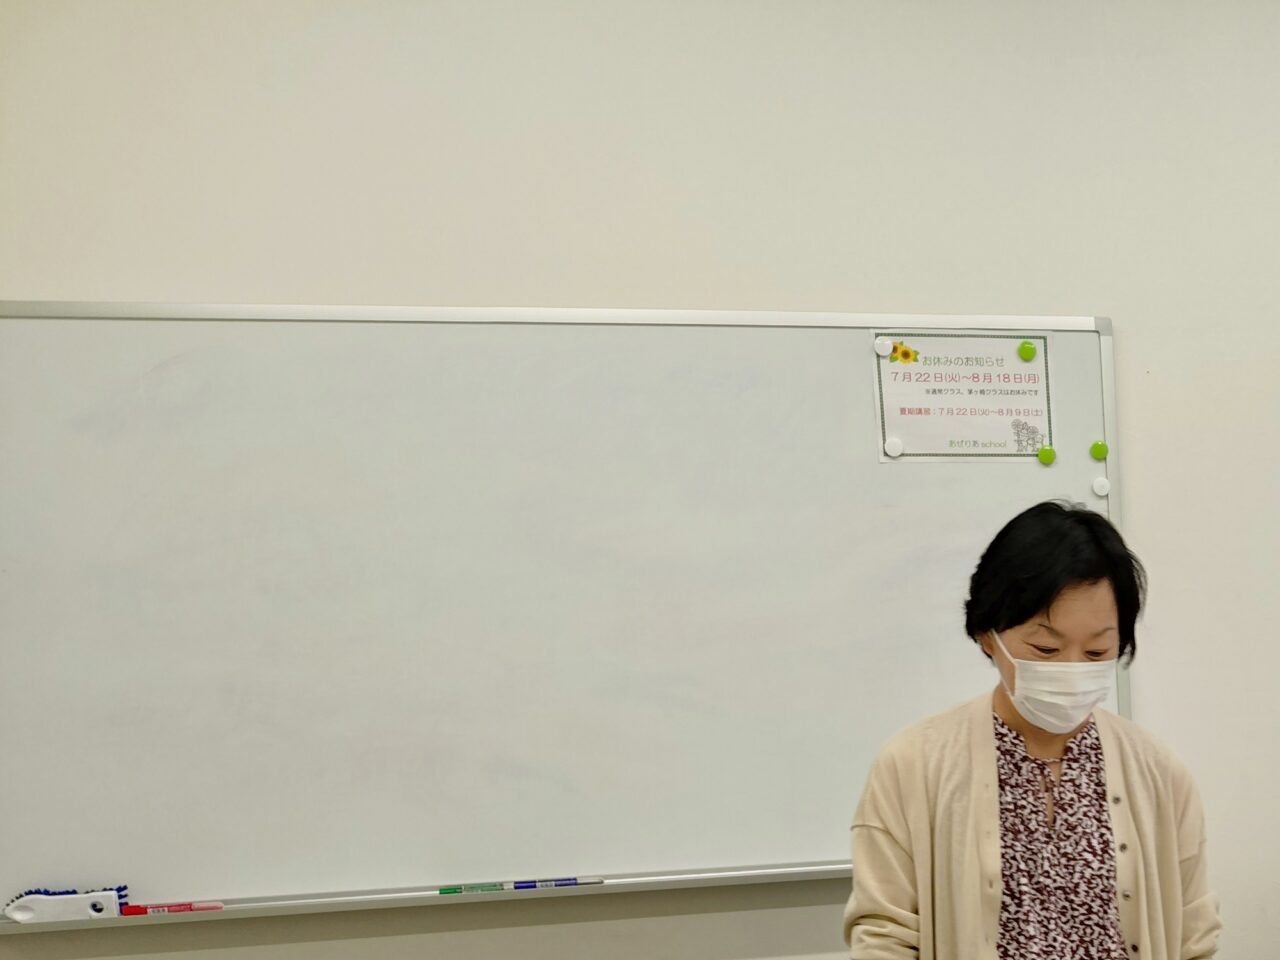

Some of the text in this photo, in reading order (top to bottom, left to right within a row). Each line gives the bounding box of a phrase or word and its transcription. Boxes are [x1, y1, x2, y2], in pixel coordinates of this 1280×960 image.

[922, 355, 1005, 368] お休みのお知らせ
[981, 439, 1007, 448] school
